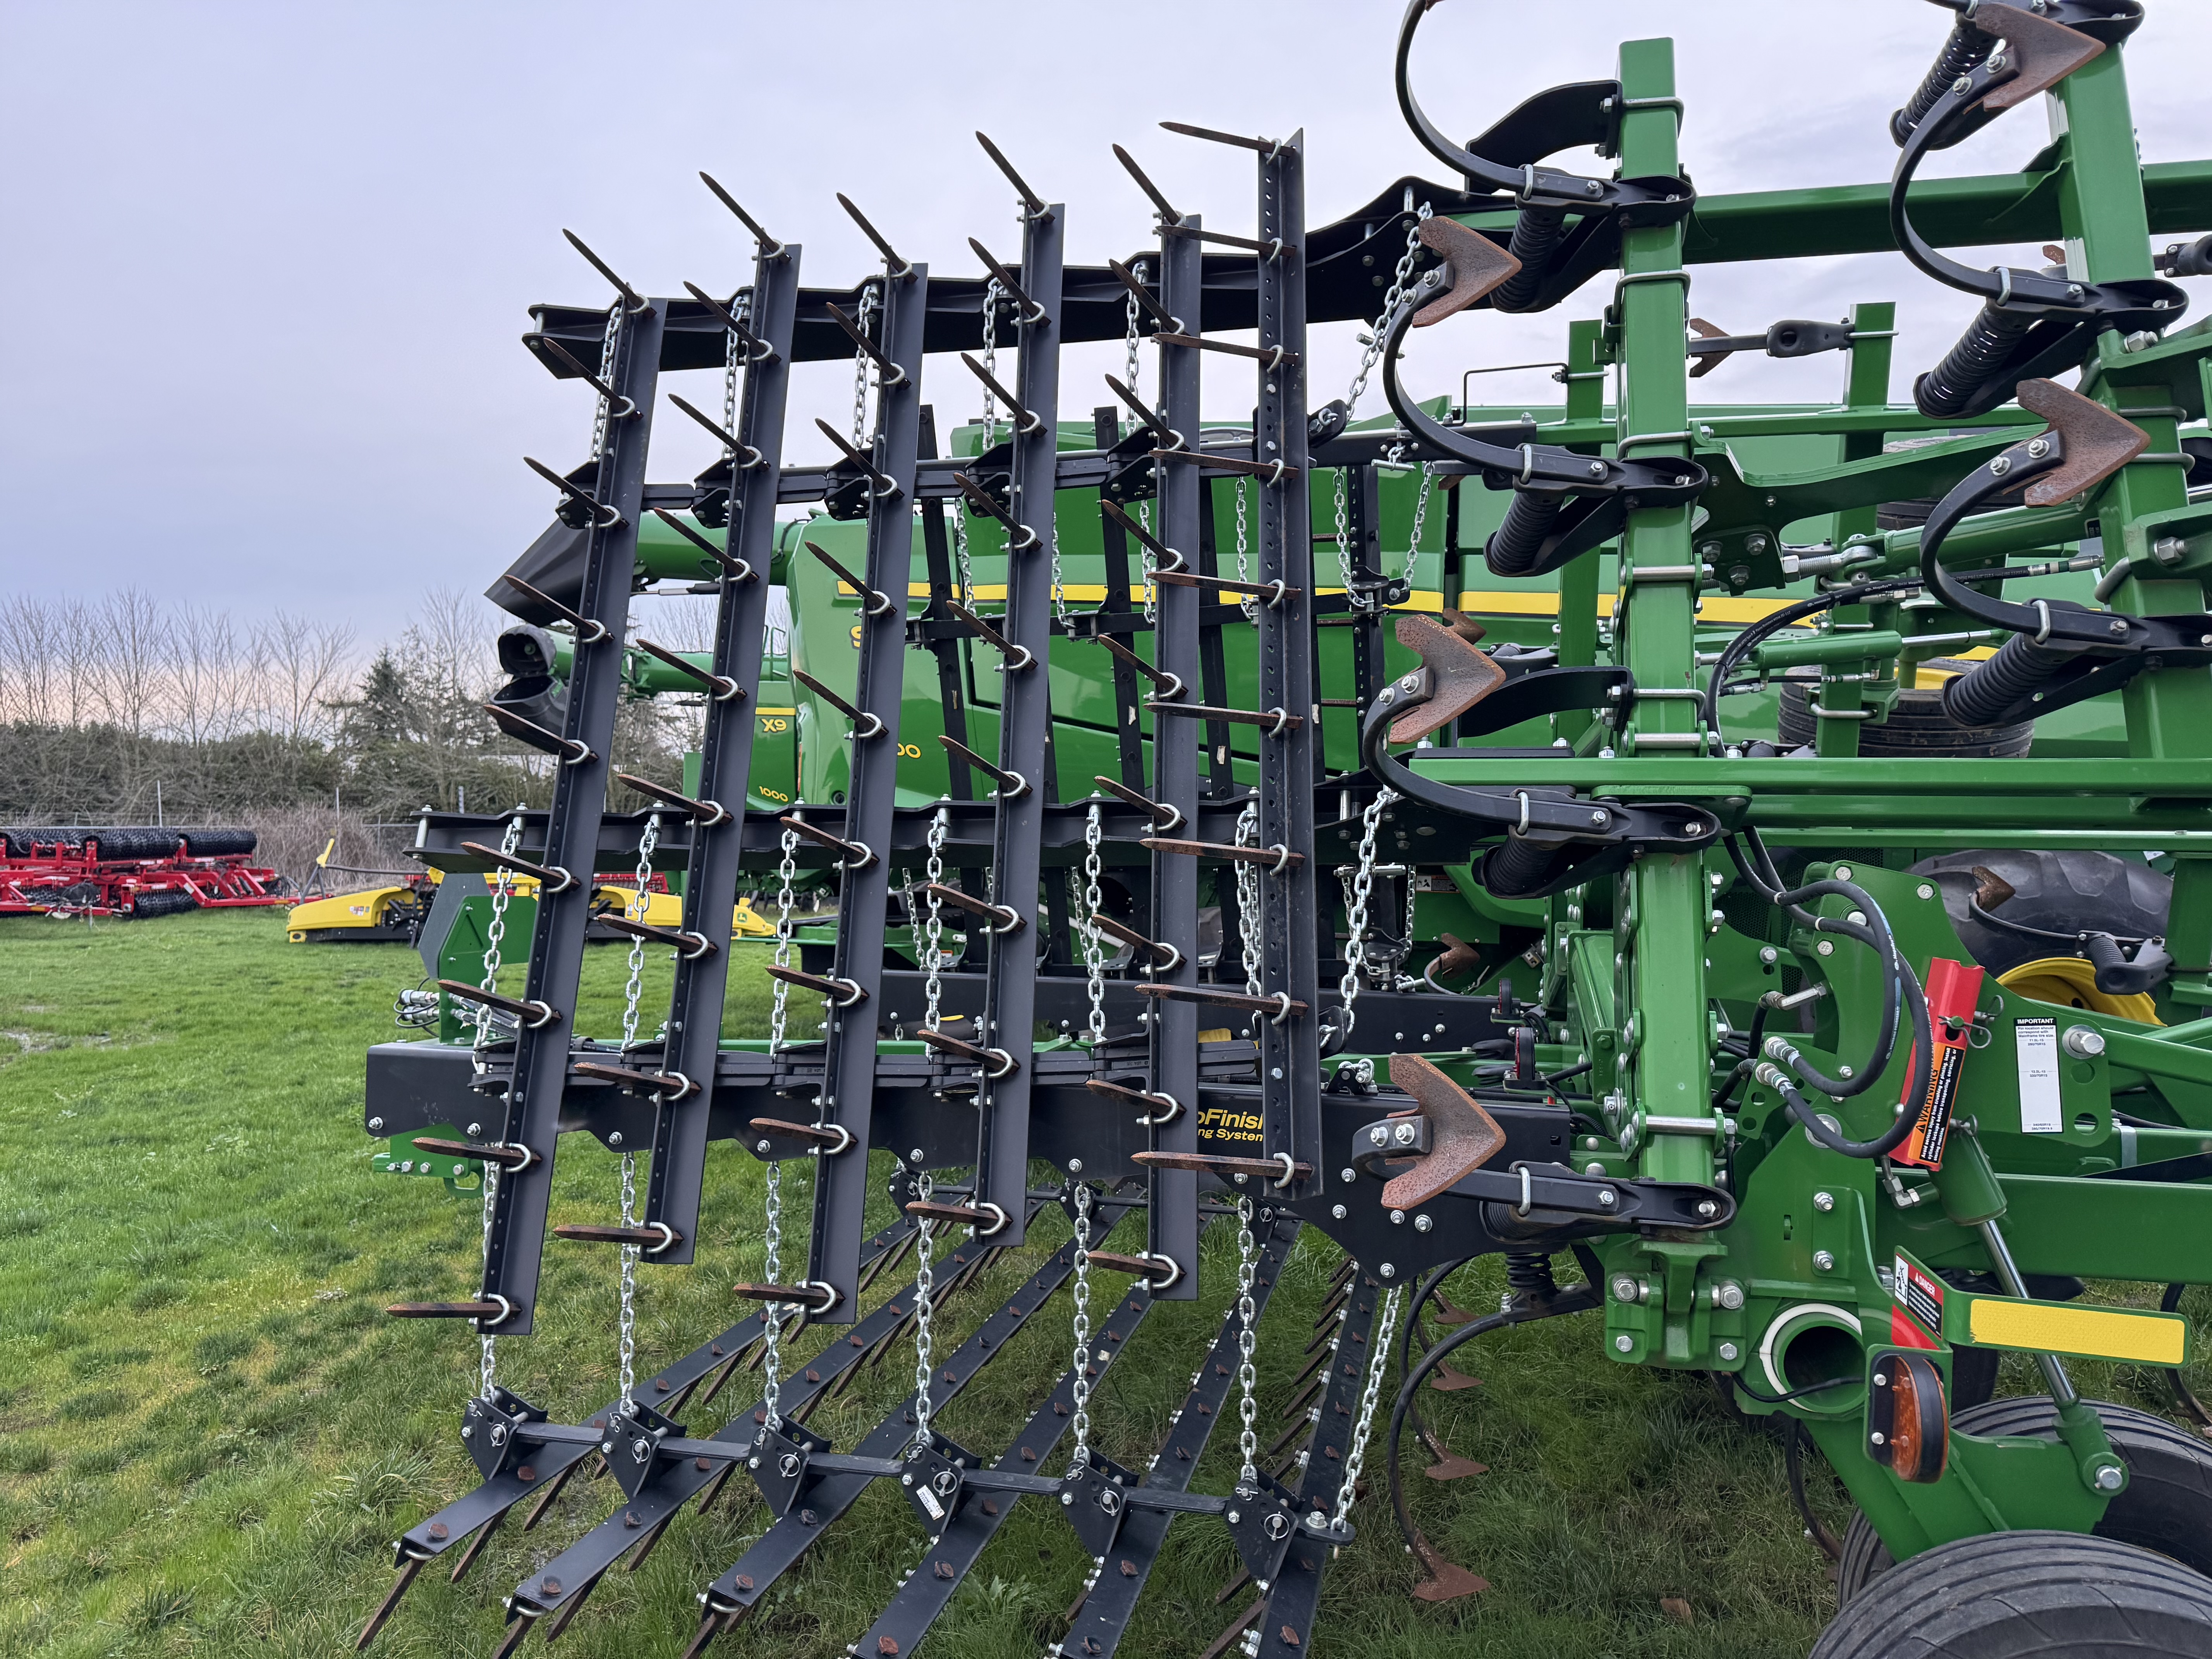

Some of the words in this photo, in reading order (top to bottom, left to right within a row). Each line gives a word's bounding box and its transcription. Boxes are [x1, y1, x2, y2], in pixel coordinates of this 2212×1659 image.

[761, 718, 787, 732] X9
[759, 786, 788, 802] 1000
[1940, 1078, 1951, 1106] transporting,
[1948, 1056, 1956, 1077] servicing,
[1918, 1070, 1938, 1121] WARNING
[1919, 1275, 1936, 1297] DANGER
